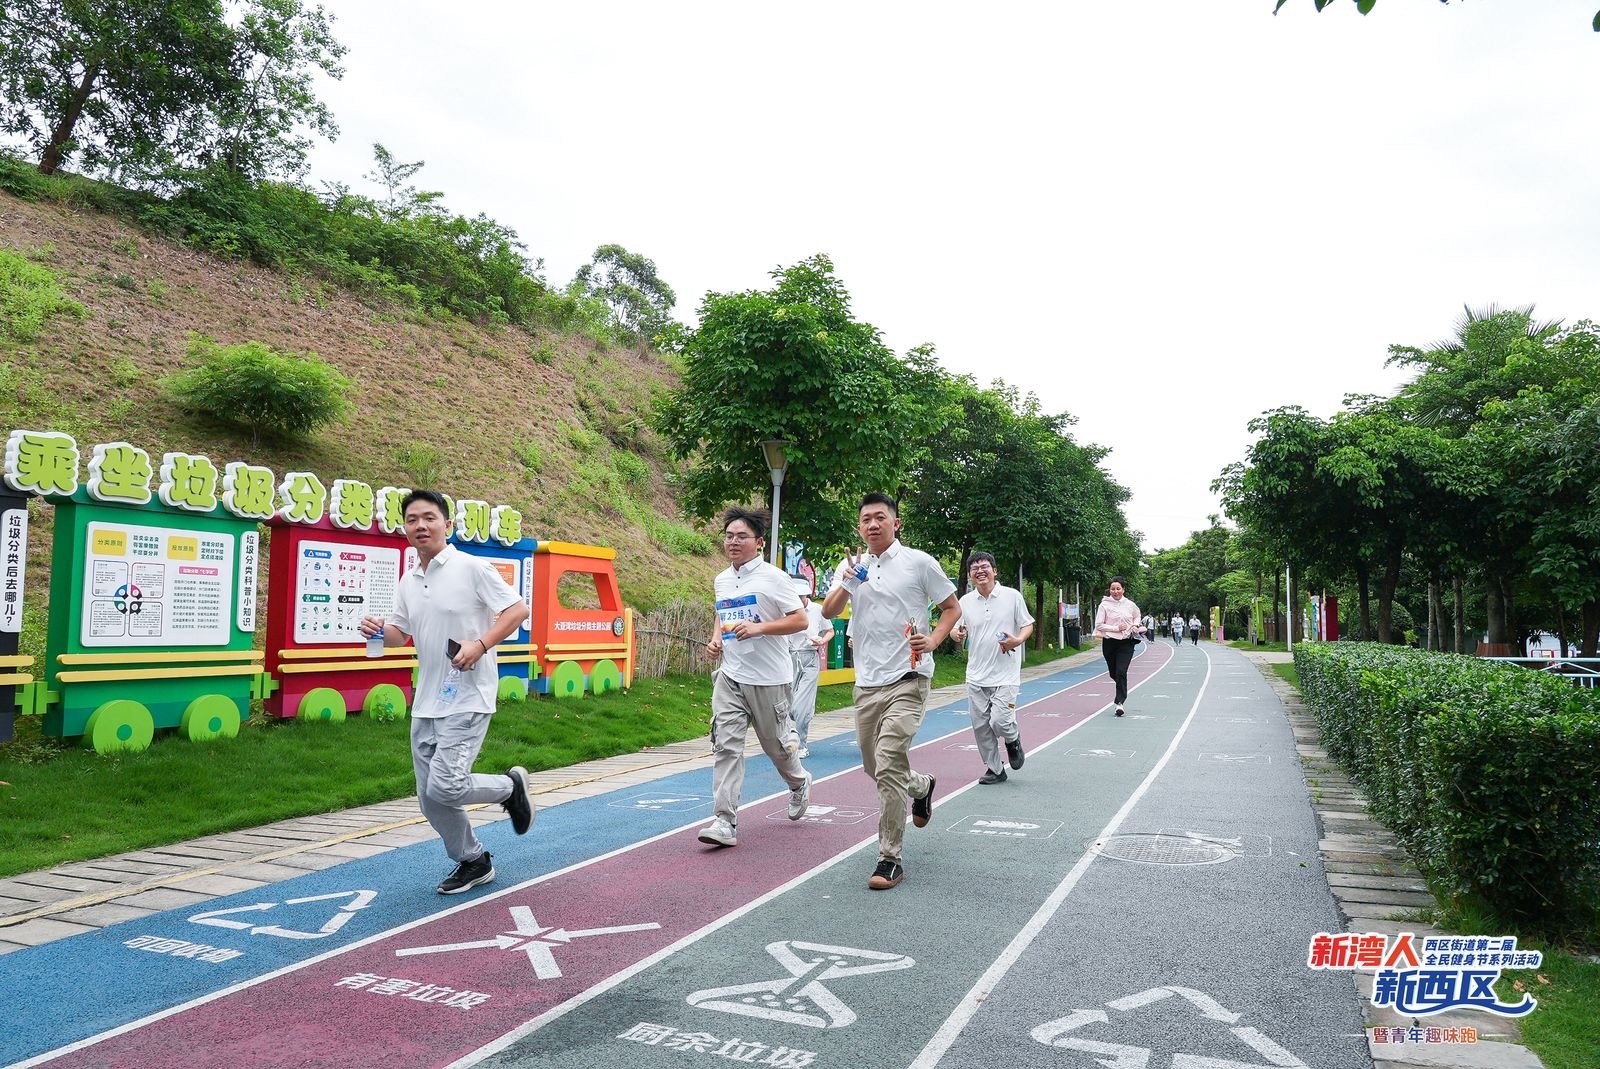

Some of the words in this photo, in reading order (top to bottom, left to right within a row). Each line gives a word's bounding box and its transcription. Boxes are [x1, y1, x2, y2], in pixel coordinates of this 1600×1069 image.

[15, 433, 522, 545] 乘坐垃圾分类列车
[97, 539, 123, 547] 分类原则
[242, 535, 254, 626] 垃圾分类科普小知识
[123, 935, 244, 963] 可回收物
[334, 972, 492, 1010] 有害垃圾
[615, 1021, 819, 1069] 厨余垃圾
